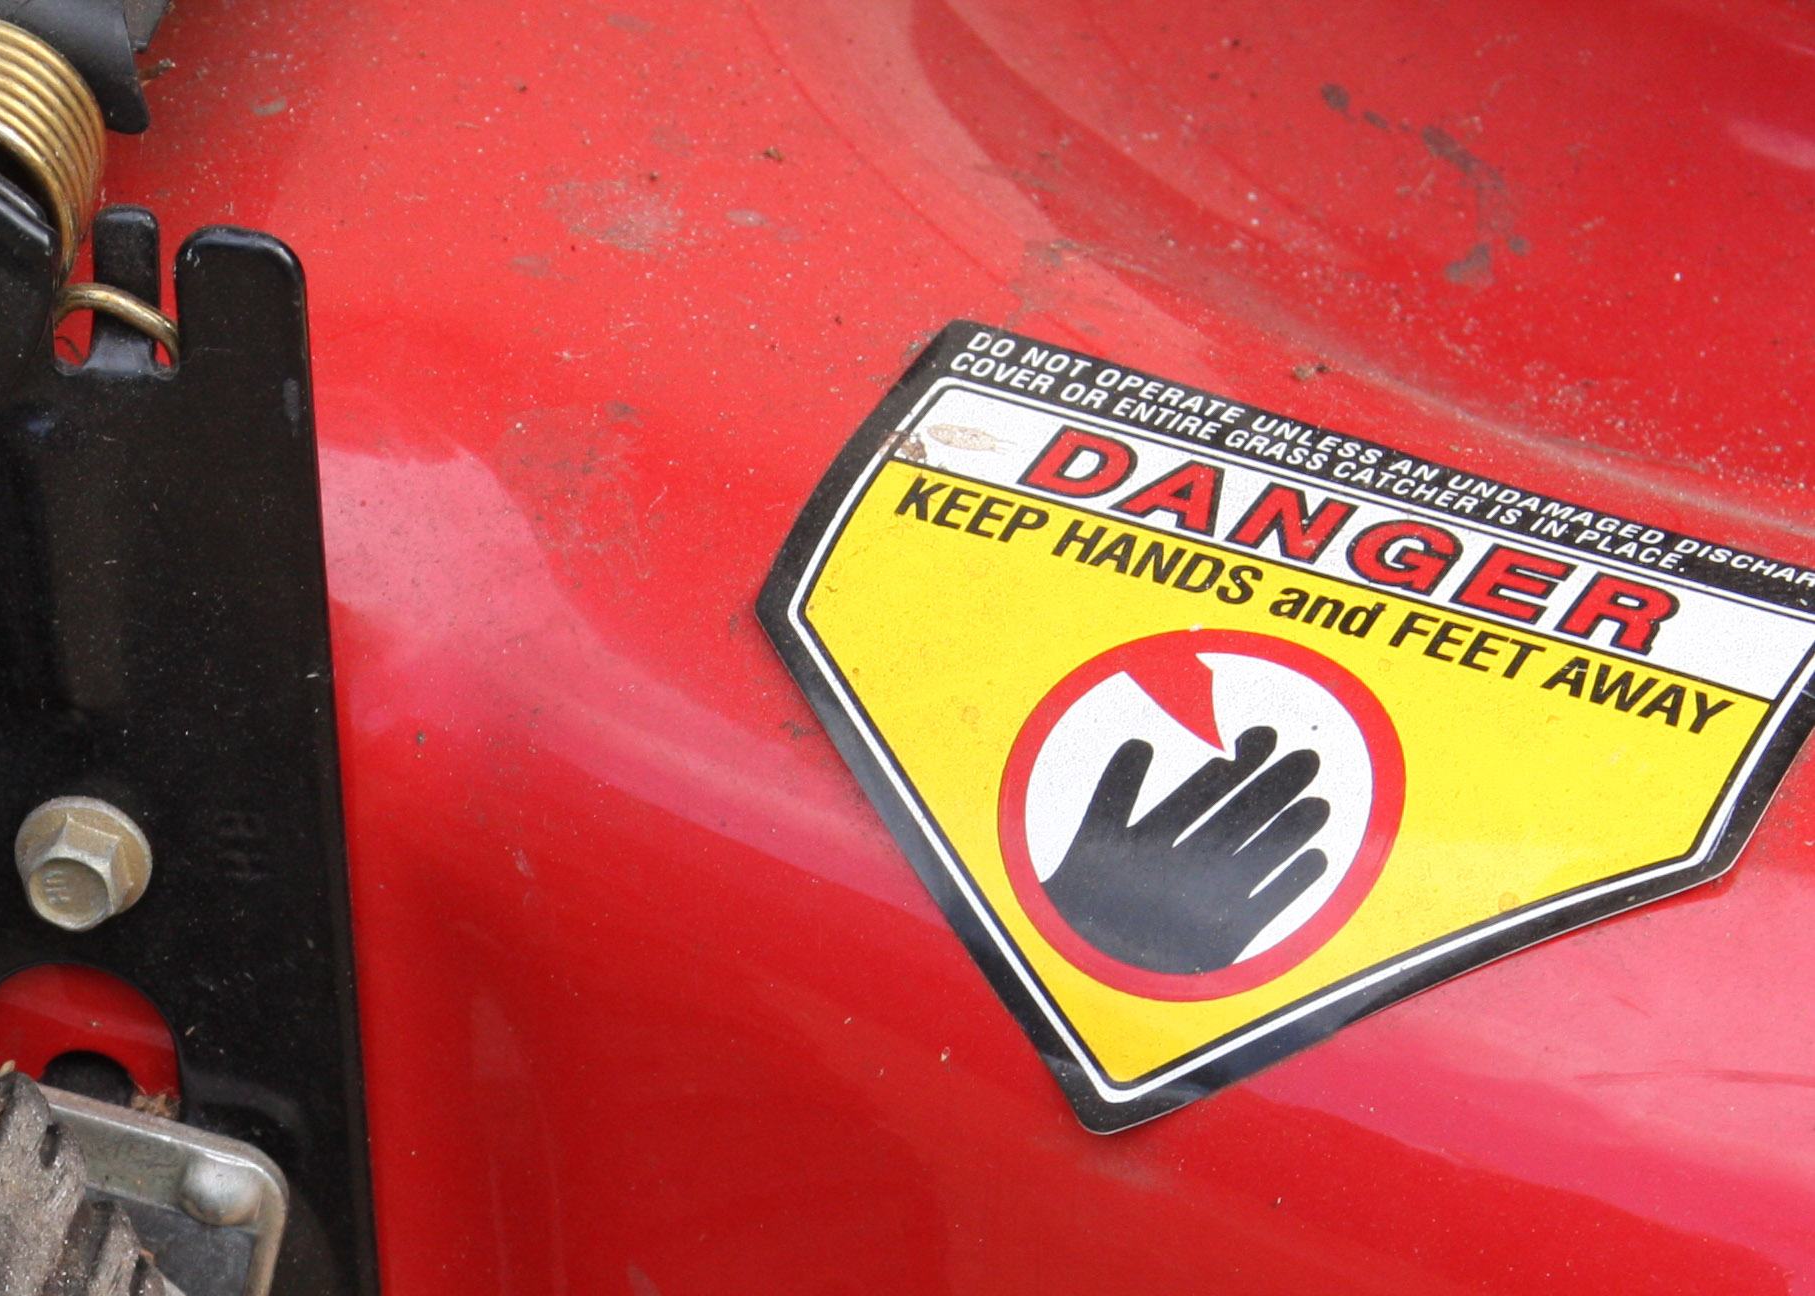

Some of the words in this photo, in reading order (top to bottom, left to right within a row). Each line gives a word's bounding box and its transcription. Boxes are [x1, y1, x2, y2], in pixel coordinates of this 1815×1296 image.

[950, 352, 1055, 395] COVER
[1060, 382, 1109, 409] OR
[1113, 396, 1222, 440] ENTIRE
[1224, 428, 1329, 471] GRASS
[1333, 461, 1479, 514] CATCHER
[1486, 504, 1523, 526] IS
[1530, 516, 1569, 538] IN
[1574, 528, 1686, 573] PLACE.
[967, 332, 1015, 358] DO
[1020, 347, 1091, 378] NOT
[1095, 368, 1245, 424] OPERATE
[1251, 414, 1382, 465] UNLESS
[1388, 459, 1440, 482] AN
[1448, 474, 1666, 545] UNDAMAGED
[1017, 424, 1680, 656] DANGER
[894, 476, 1050, 543] KEEP
[1052, 518, 1263, 605] HANDS
[1269, 586, 1388, 638] and
[1389, 611, 1547, 679] FEET
[1541, 656, 1734, 735] AWAY
